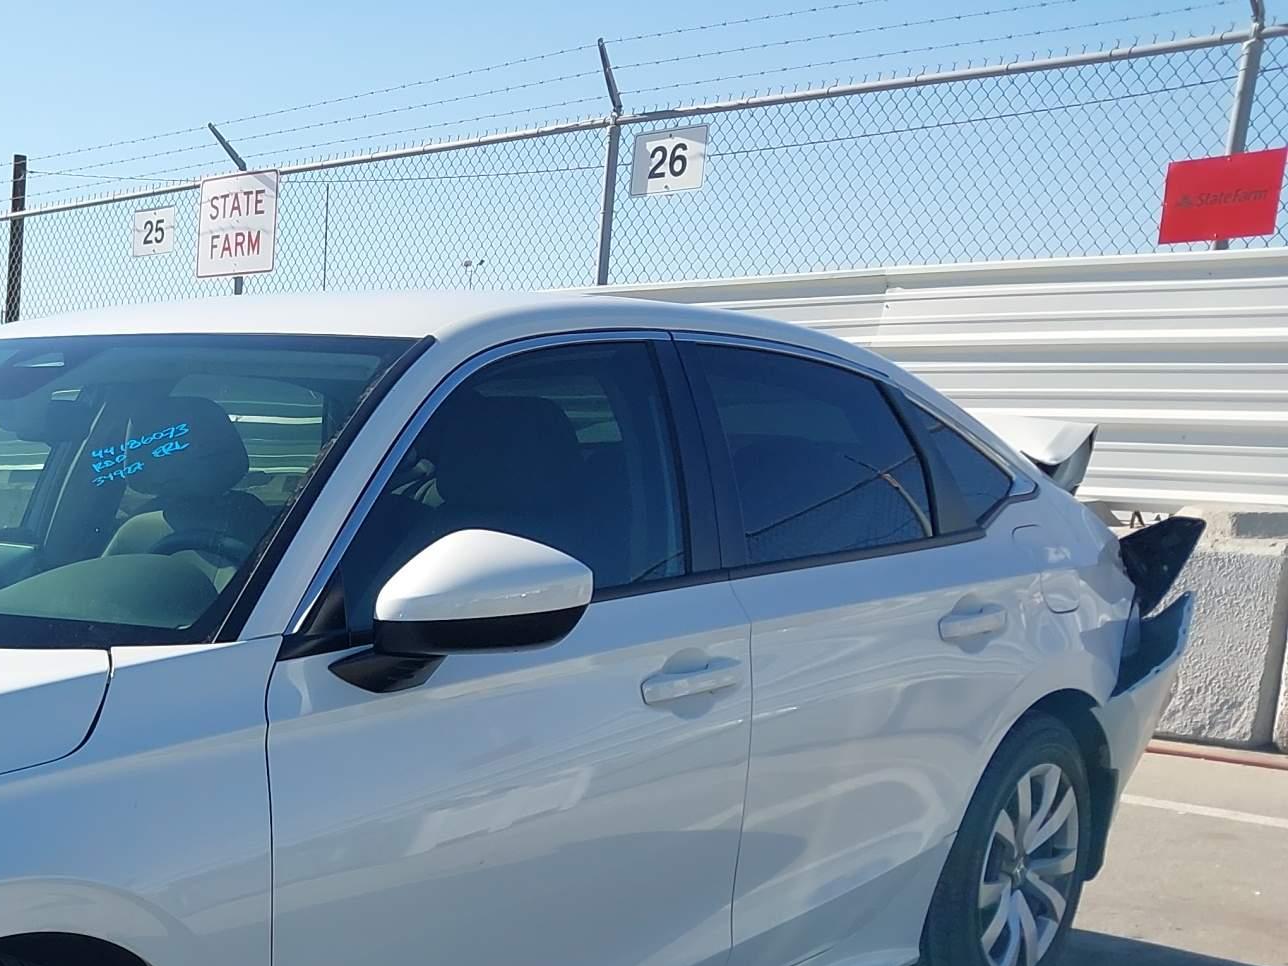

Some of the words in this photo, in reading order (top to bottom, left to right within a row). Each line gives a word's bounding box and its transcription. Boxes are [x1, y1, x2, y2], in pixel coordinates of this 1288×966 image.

[648, 142, 688, 179] 26
[209, 189, 265, 220] STATE
[143, 219, 165, 245] 25
[210, 230, 261, 260] FARM
